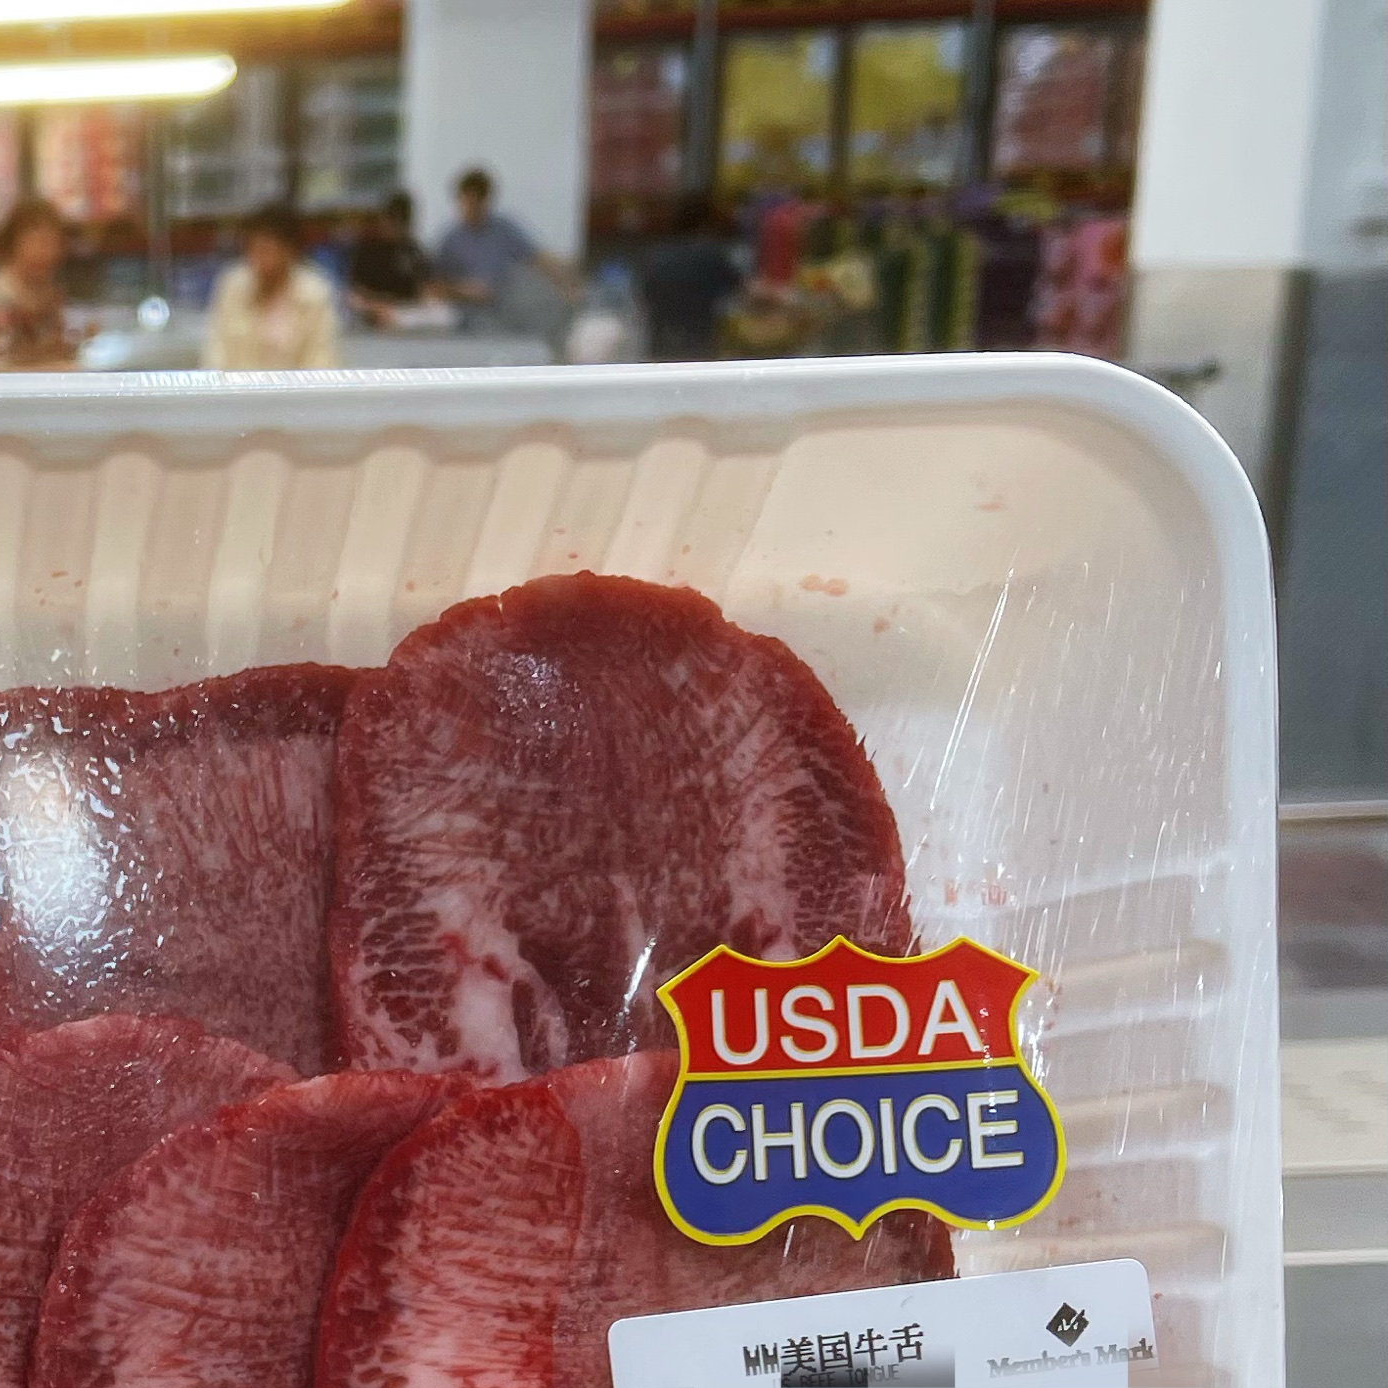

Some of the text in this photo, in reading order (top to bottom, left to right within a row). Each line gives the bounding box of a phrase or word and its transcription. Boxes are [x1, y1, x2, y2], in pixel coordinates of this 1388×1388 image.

[710, 979, 985, 1066] USDA
[691, 1088, 1025, 1186] CHOICE
[1094, 1338, 1153, 1366] Mark
